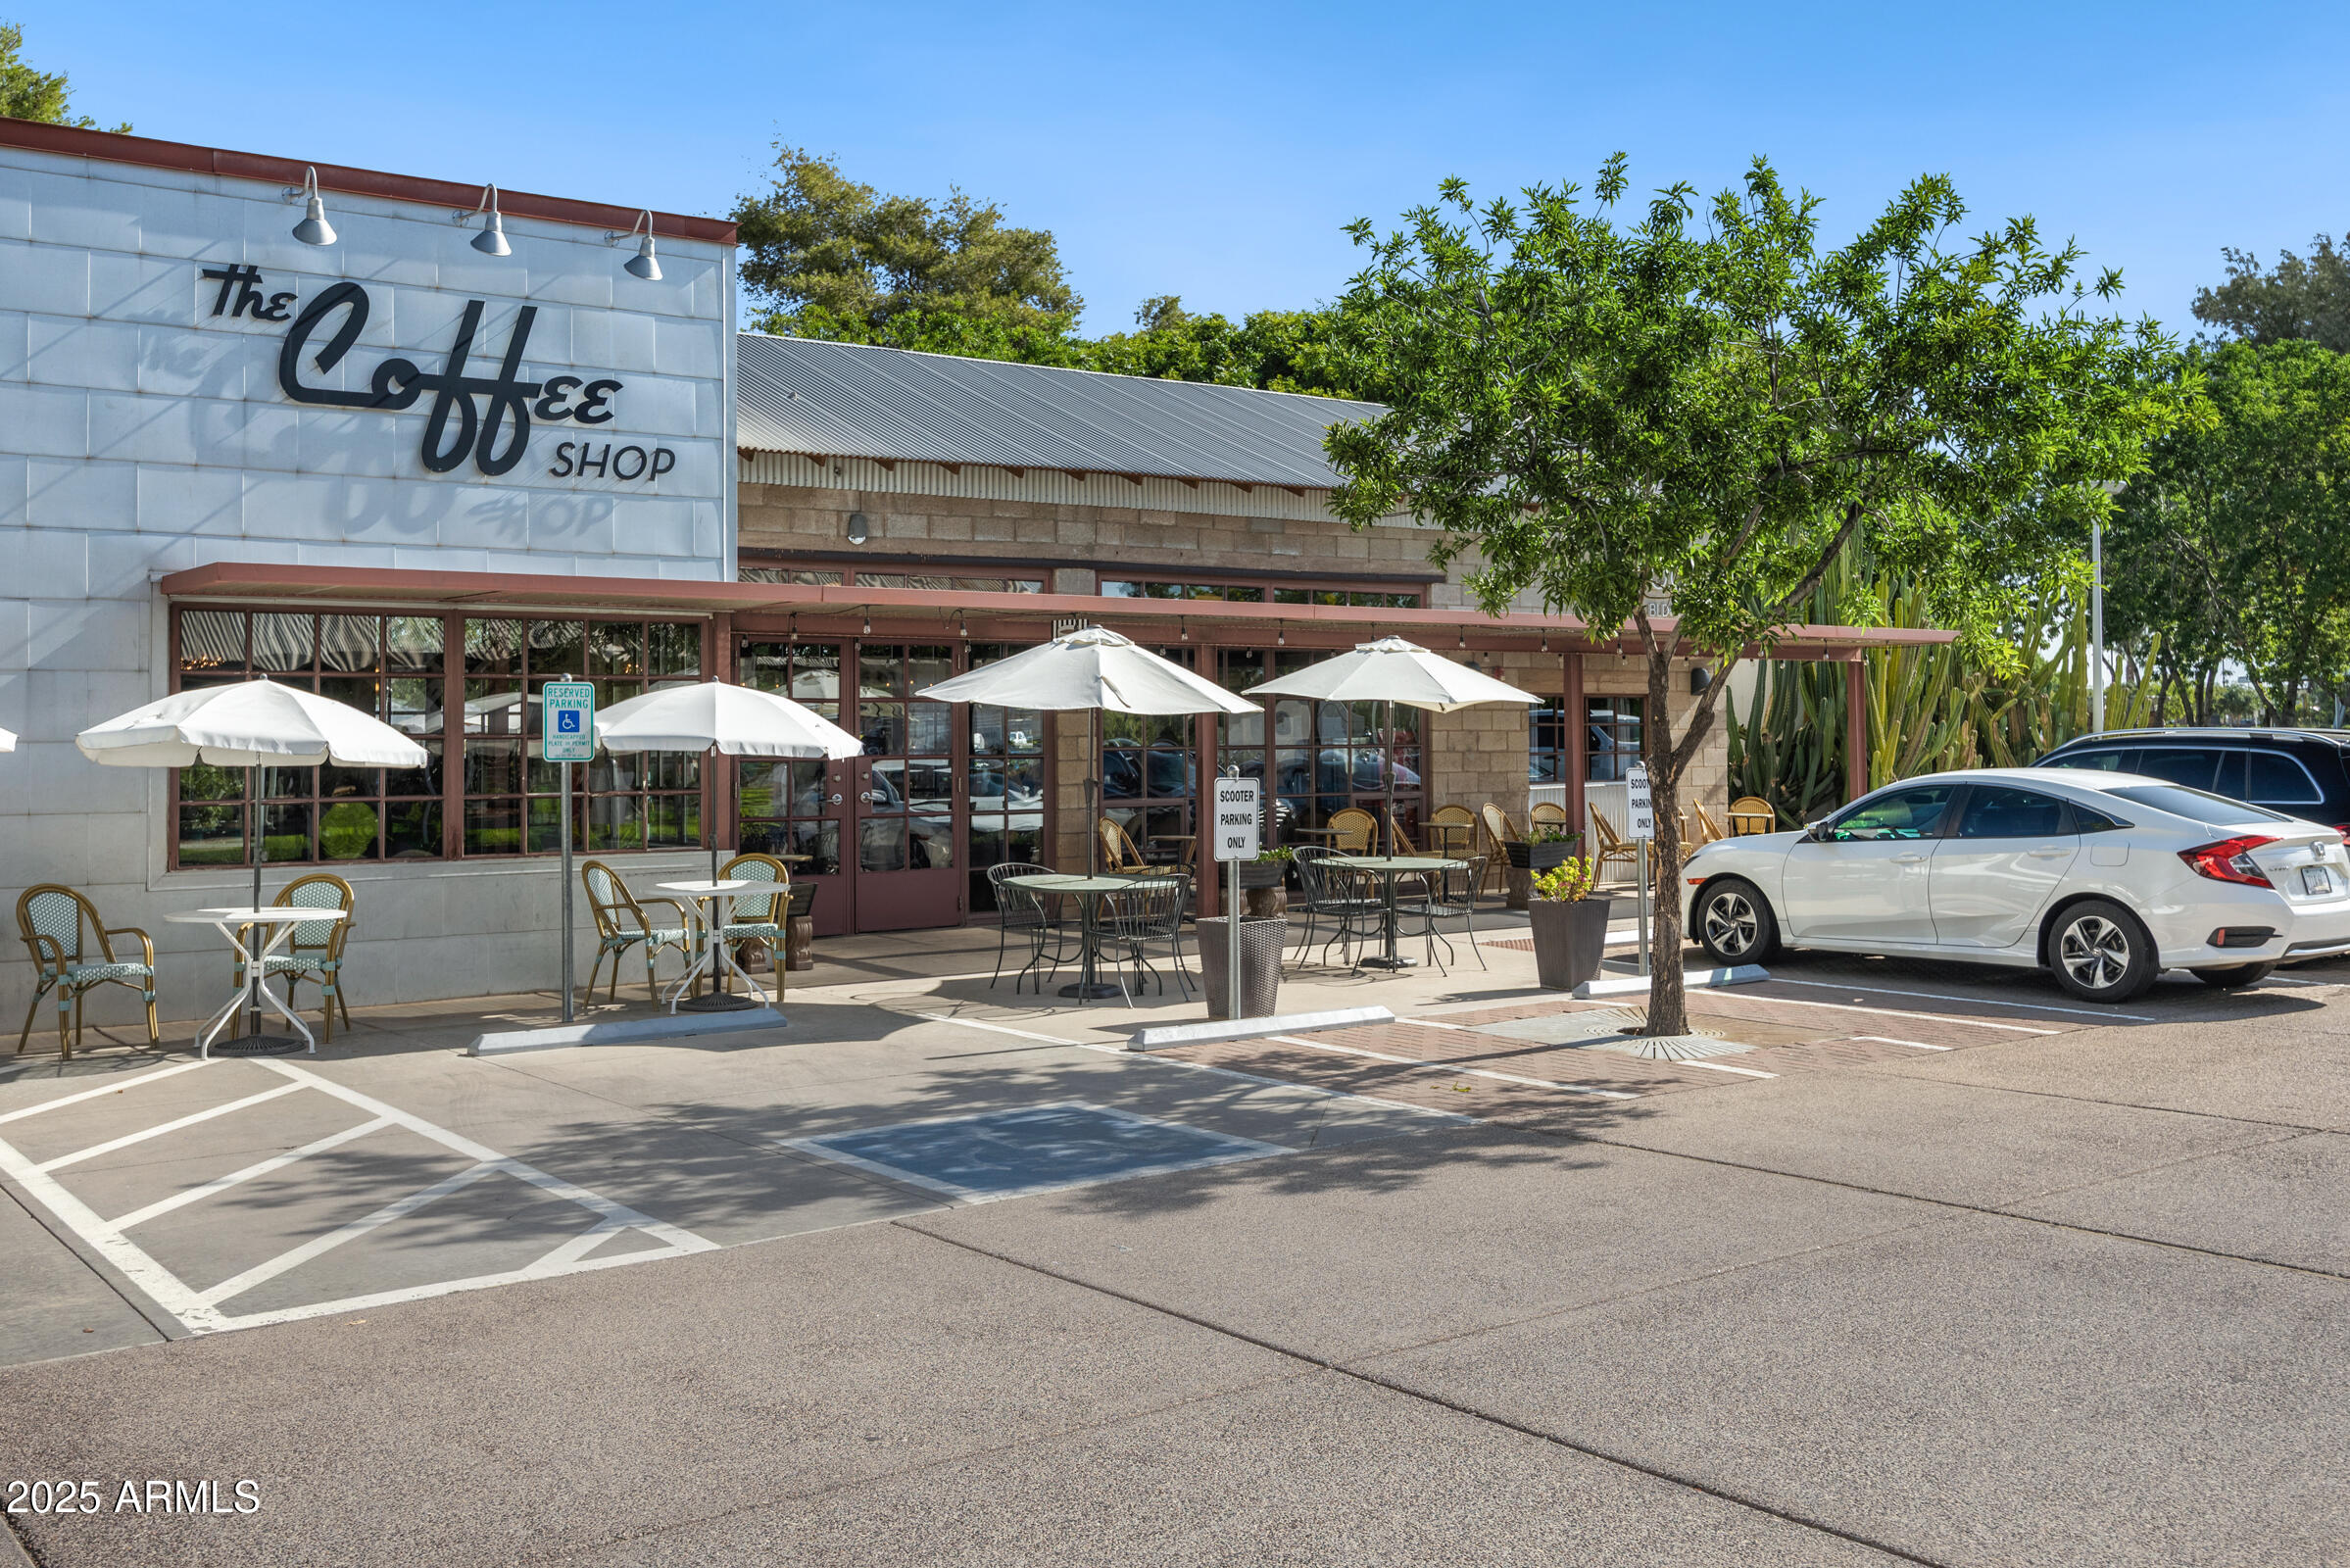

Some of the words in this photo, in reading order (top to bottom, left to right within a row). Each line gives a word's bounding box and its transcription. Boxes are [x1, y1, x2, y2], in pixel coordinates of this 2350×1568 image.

[550, 441, 676, 481] SHOP
[548, 688, 590, 698] RESERVED
[549, 699, 589, 709] PARKING
[1631, 778, 1650, 790] SCOOT
[1220, 790, 1254, 803] SCOOTER
[1631, 798, 1652, 809] PARKIN
[1220, 813, 1252, 826] PARKING
[1637, 817, 1652, 829] ONLY
[1227, 836, 1246, 849] ONLY
